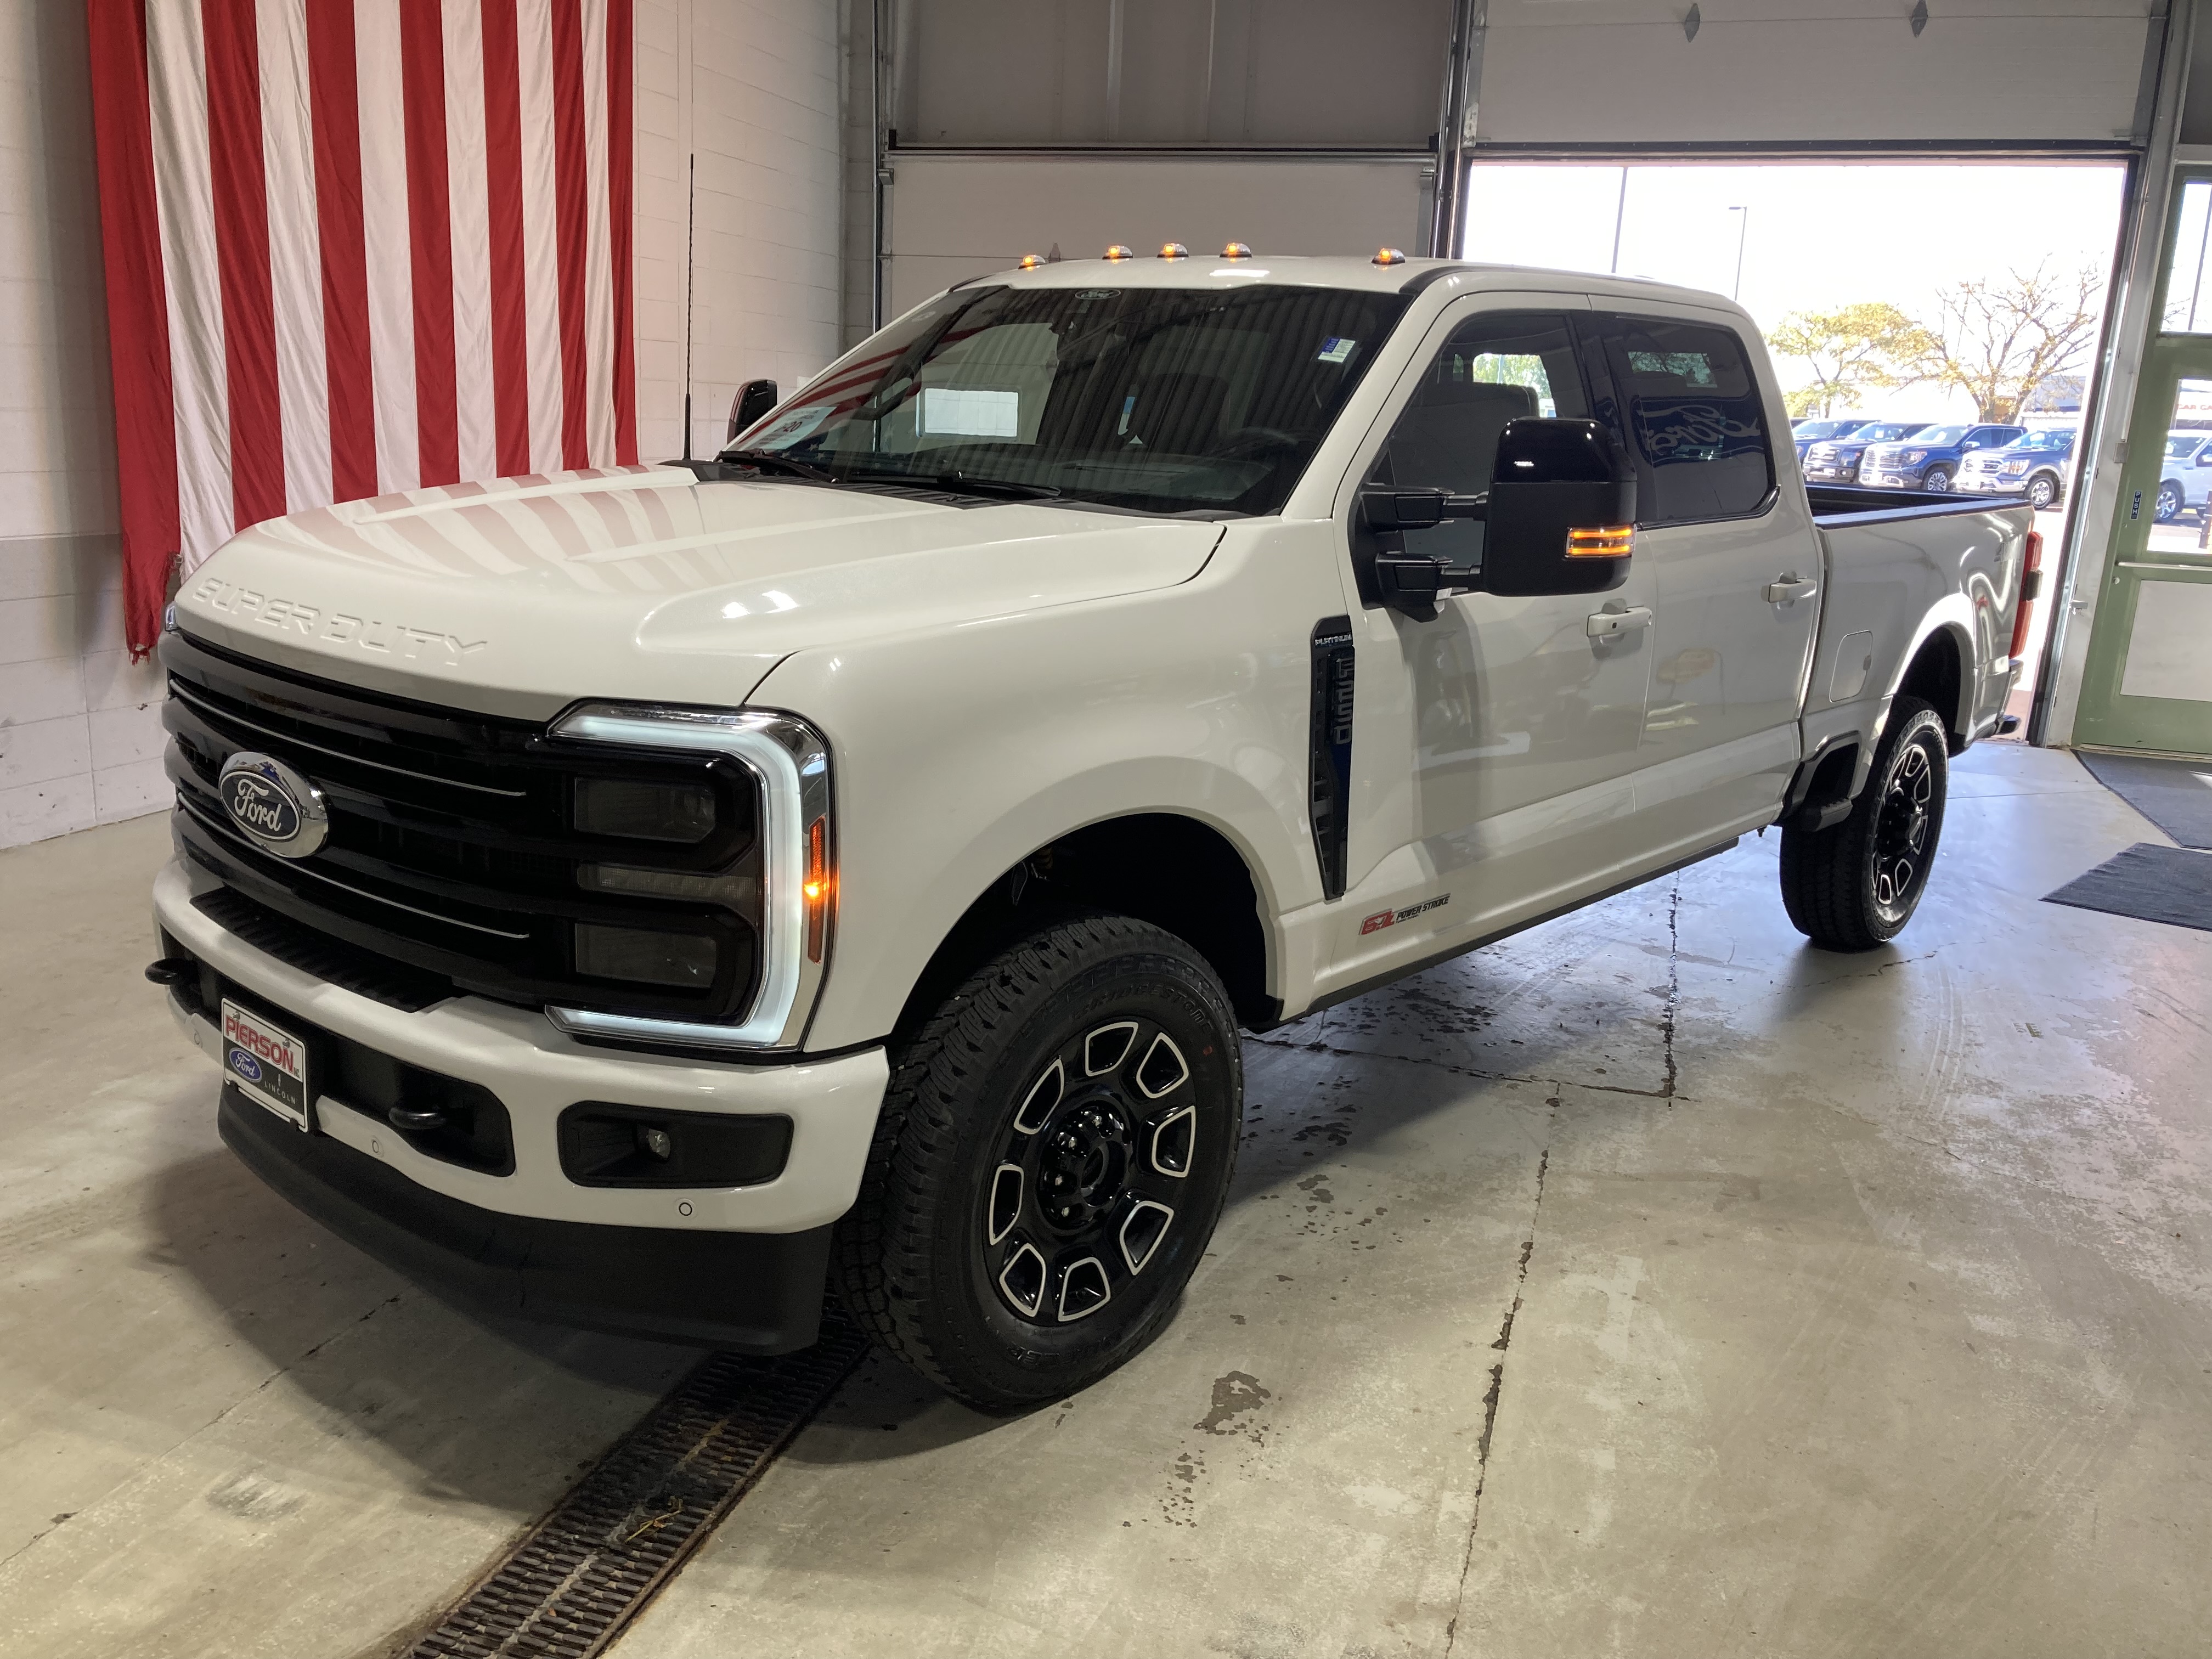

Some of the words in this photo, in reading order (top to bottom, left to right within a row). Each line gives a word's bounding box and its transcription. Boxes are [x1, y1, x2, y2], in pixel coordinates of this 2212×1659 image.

[2132, 492, 2141, 515] PUSH
[192, 578, 321, 635] SUPER
[320, 613, 488, 666] DUTY
[1314, 634, 1352, 646] PLATINUM
[234, 778, 281, 832] Ford
[1396, 905, 1422, 921] POWER
[1421, 895, 1450, 912] STROKE
[225, 1014, 295, 1075] PIERSON
[235, 1052, 255, 1076] Ford
[264, 1080, 296, 1104] LINCOLN
